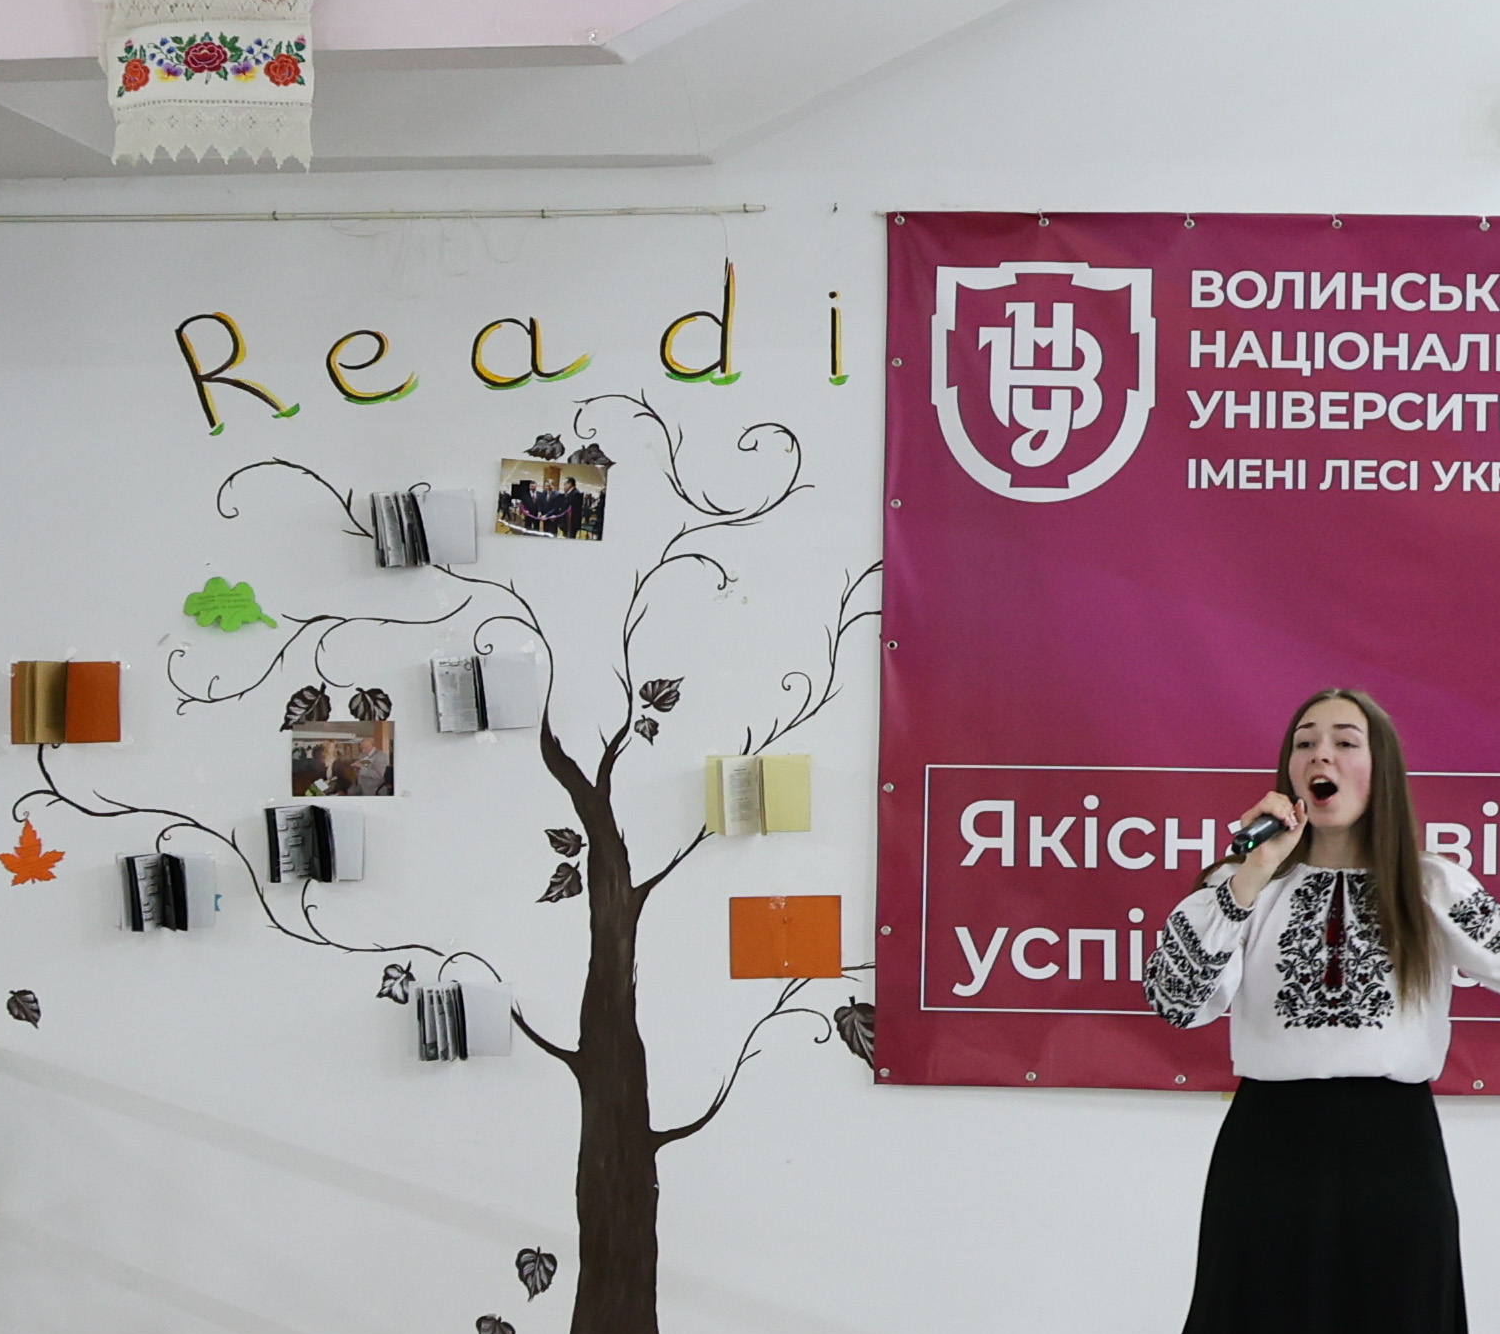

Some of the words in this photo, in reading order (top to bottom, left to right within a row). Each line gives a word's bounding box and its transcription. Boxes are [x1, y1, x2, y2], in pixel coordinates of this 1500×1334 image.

[1187, 458, 1307, 491] ІМЕНІ
[1319, 459, 1420, 492] ЛЕСІ
[959, 794, 1243, 871] Якісн
[951, 907, 1165, 998] успі
